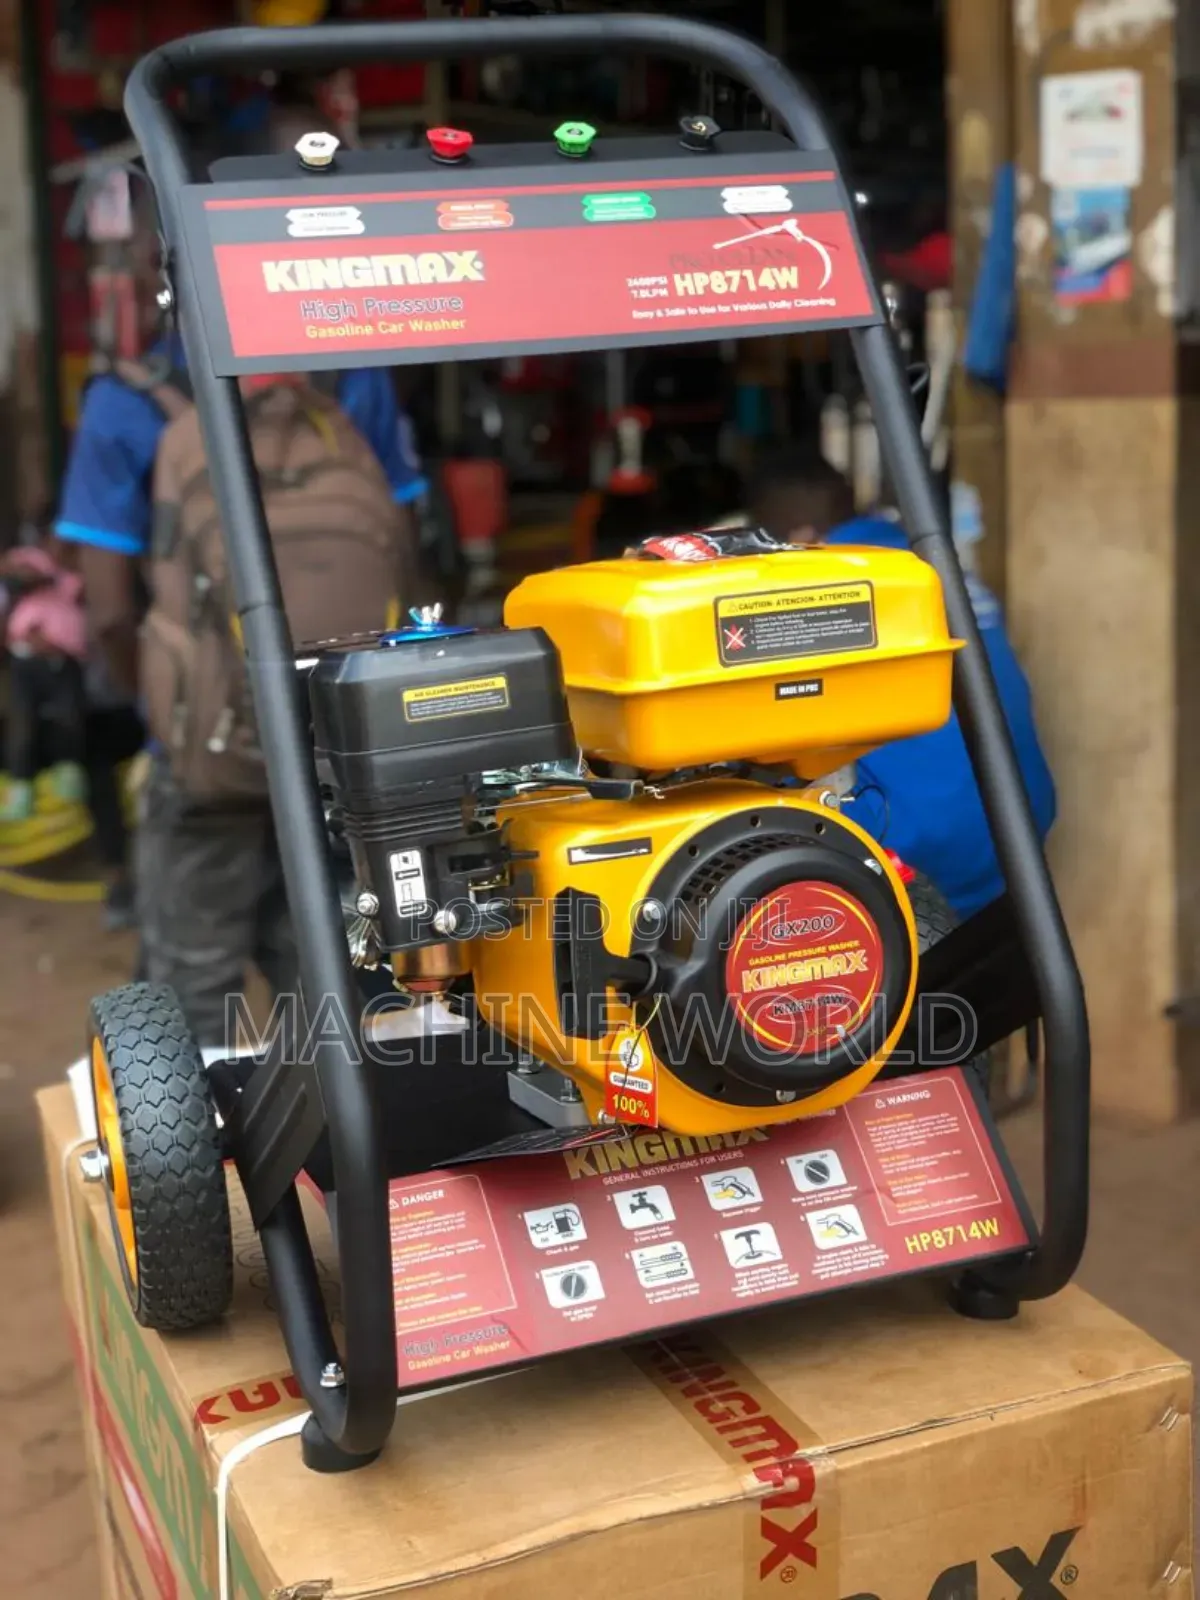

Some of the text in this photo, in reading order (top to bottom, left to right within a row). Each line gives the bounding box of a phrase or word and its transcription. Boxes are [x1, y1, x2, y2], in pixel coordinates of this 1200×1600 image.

[673, 266, 799, 297] HP8714W
[300, 296, 463, 322] High Pressure
[306, 317, 466, 339] Gasoline Car Washer
[771, 914, 835, 939] GX200
[748, 952, 787, 967] GASOLINE
[787, 945, 828, 959] PRESSURE
[742, 949, 868, 993] KINGMAX
[613, 1094, 650, 1119] 100%
[887, 1089, 932, 1106] WARNING
[602, 1150, 745, 1186] GENERAL INSTRUCTIONS FOR USERS
[401, 1188, 445, 1207] DANGER
[904, 1217, 1000, 1255] HP8714W
[404, 1324, 510, 1357] High Pressure
[408, 1339, 511, 1371] Gasoline Car Washer
